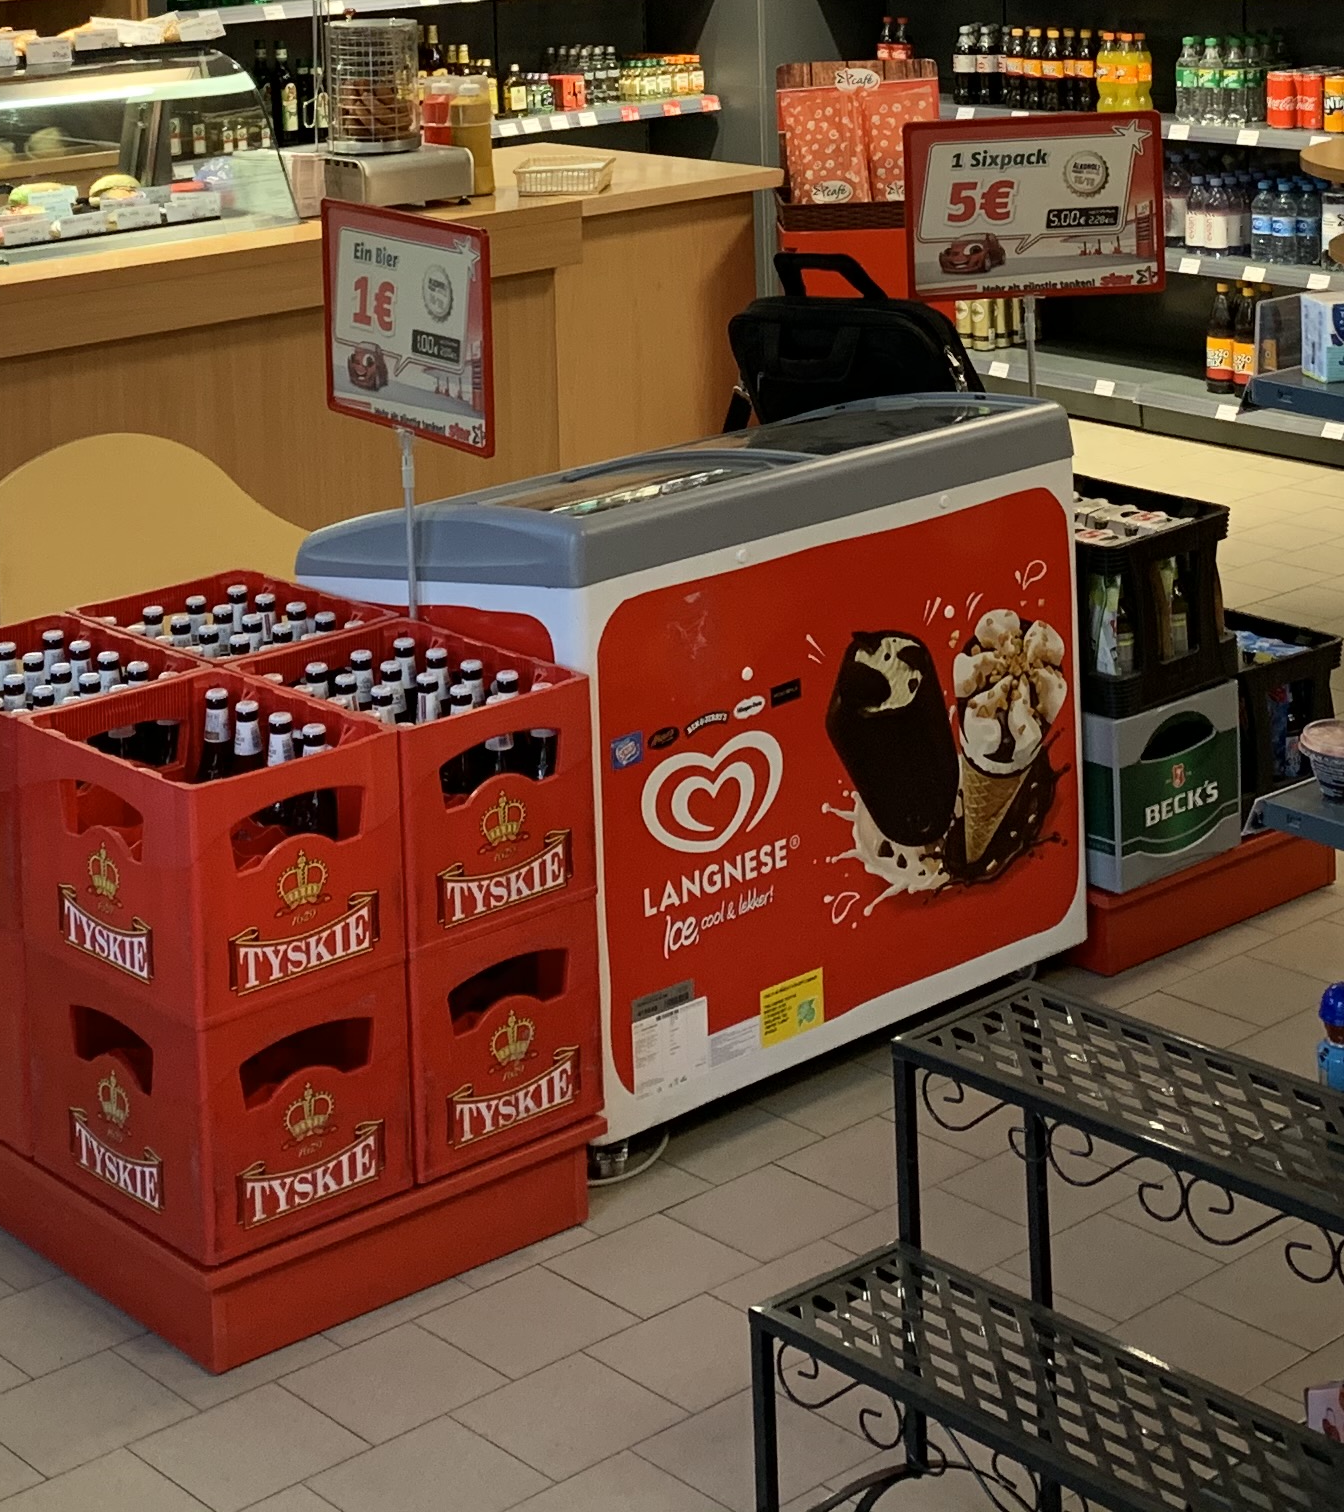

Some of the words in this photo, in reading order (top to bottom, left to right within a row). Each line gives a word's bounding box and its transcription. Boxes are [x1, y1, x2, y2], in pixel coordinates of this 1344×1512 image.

[851, 72, 875, 85] café
[951, 152, 963, 169] 1
[970, 148, 1048, 170] Sixpack
[946, 179, 1016, 223] 5€
[353, 242, 372, 262] Ein
[375, 246, 399, 268] Bier
[352, 275, 395, 332] 1€
[1144, 779, 1220, 827] BECK'S
[446, 843, 566, 922] TYSKIE
[644, 838, 789, 918] LANGNESE
[701, 903, 725, 930] cool
[726, 901, 737, 921] &
[738, 885, 775, 915] lekker!
[63, 897, 149, 982] TYSKIE
[239, 906, 370, 989] TYSKIE
[455, 1060, 573, 1145] TYSKIE
[74, 1124, 160, 1209] TYSKIE
[245, 1127, 377, 1227] TYSKIE
